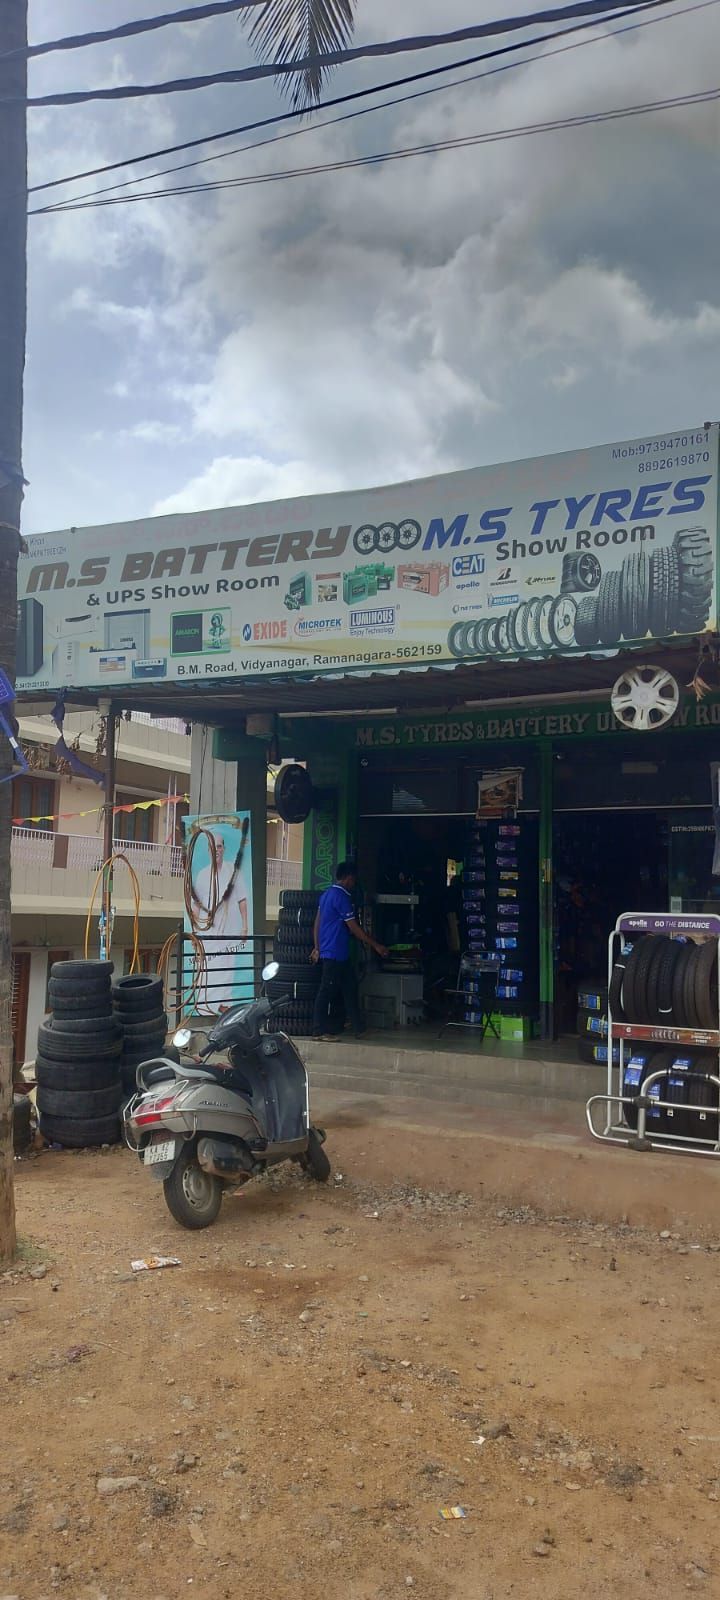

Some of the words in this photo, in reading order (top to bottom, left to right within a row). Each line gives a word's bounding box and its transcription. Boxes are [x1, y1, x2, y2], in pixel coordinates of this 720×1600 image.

[638, 451, 710, 473] 8892619870
[422, 506, 513, 551] M.S
[529, 474, 713, 535] TYRES
[496, 536, 567, 561] Show
[576, 524, 655, 550] Room
[26, 556, 110, 593] M.S
[120, 525, 352, 583] BATTERY
[453, 555, 485, 575] CEAT
[87, 594, 100, 606] &
[106, 588, 146, 604] UPS
[151, 584, 209, 600] Show
[216, 575, 279, 593] Room
[456, 581, 480, 591] apollo
[298, 618, 342, 630] MICROTEK
[351, 609, 393, 627] LUMINOUS
[253, 620, 288, 640] EXIDE
[178, 664, 201, 675] B.M.
[205, 662, 237, 674] Road,
[241, 656, 309, 672] Vidyanagar,
[313, 644, 442, 665] Ramanagara-562159
[354, 727, 400, 746] M.S.
[404, 721, 474, 743] TYRES
[487, 714, 590, 739] BATTERY
[678, 921, 710, 929] DISTANCE
